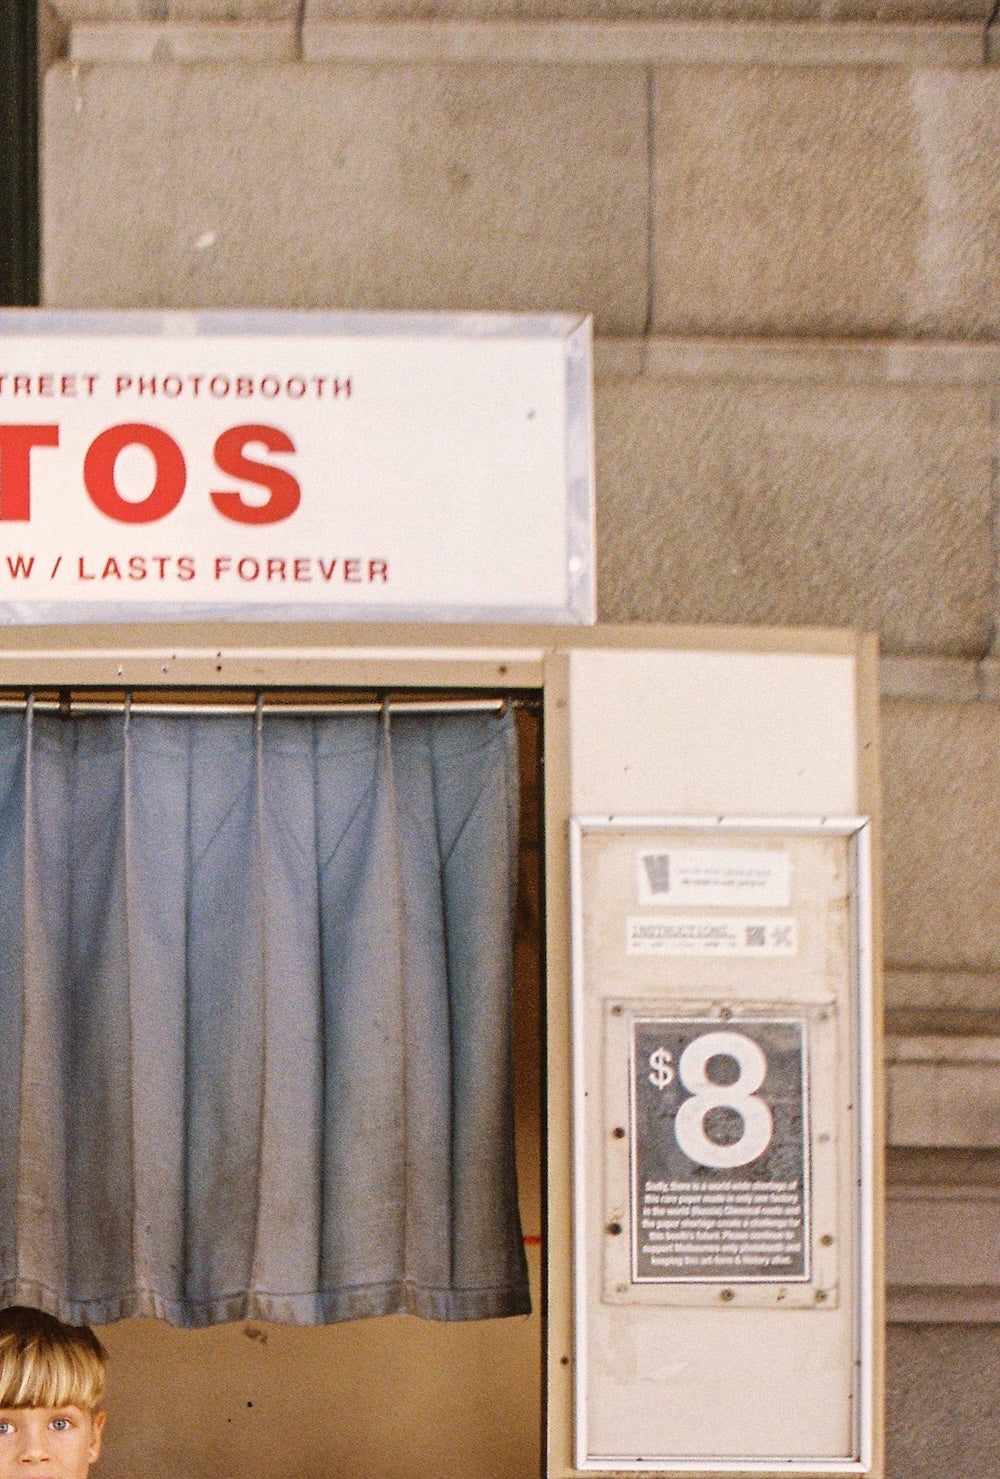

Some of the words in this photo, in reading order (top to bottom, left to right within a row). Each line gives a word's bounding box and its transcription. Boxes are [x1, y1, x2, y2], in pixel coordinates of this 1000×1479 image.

[114, 373, 354, 399] PHOTOBOOTH
[78, 555, 196, 581] LASTS
[214, 556, 390, 582] FOREVER
[648, 1030, 774, 1169] $8
